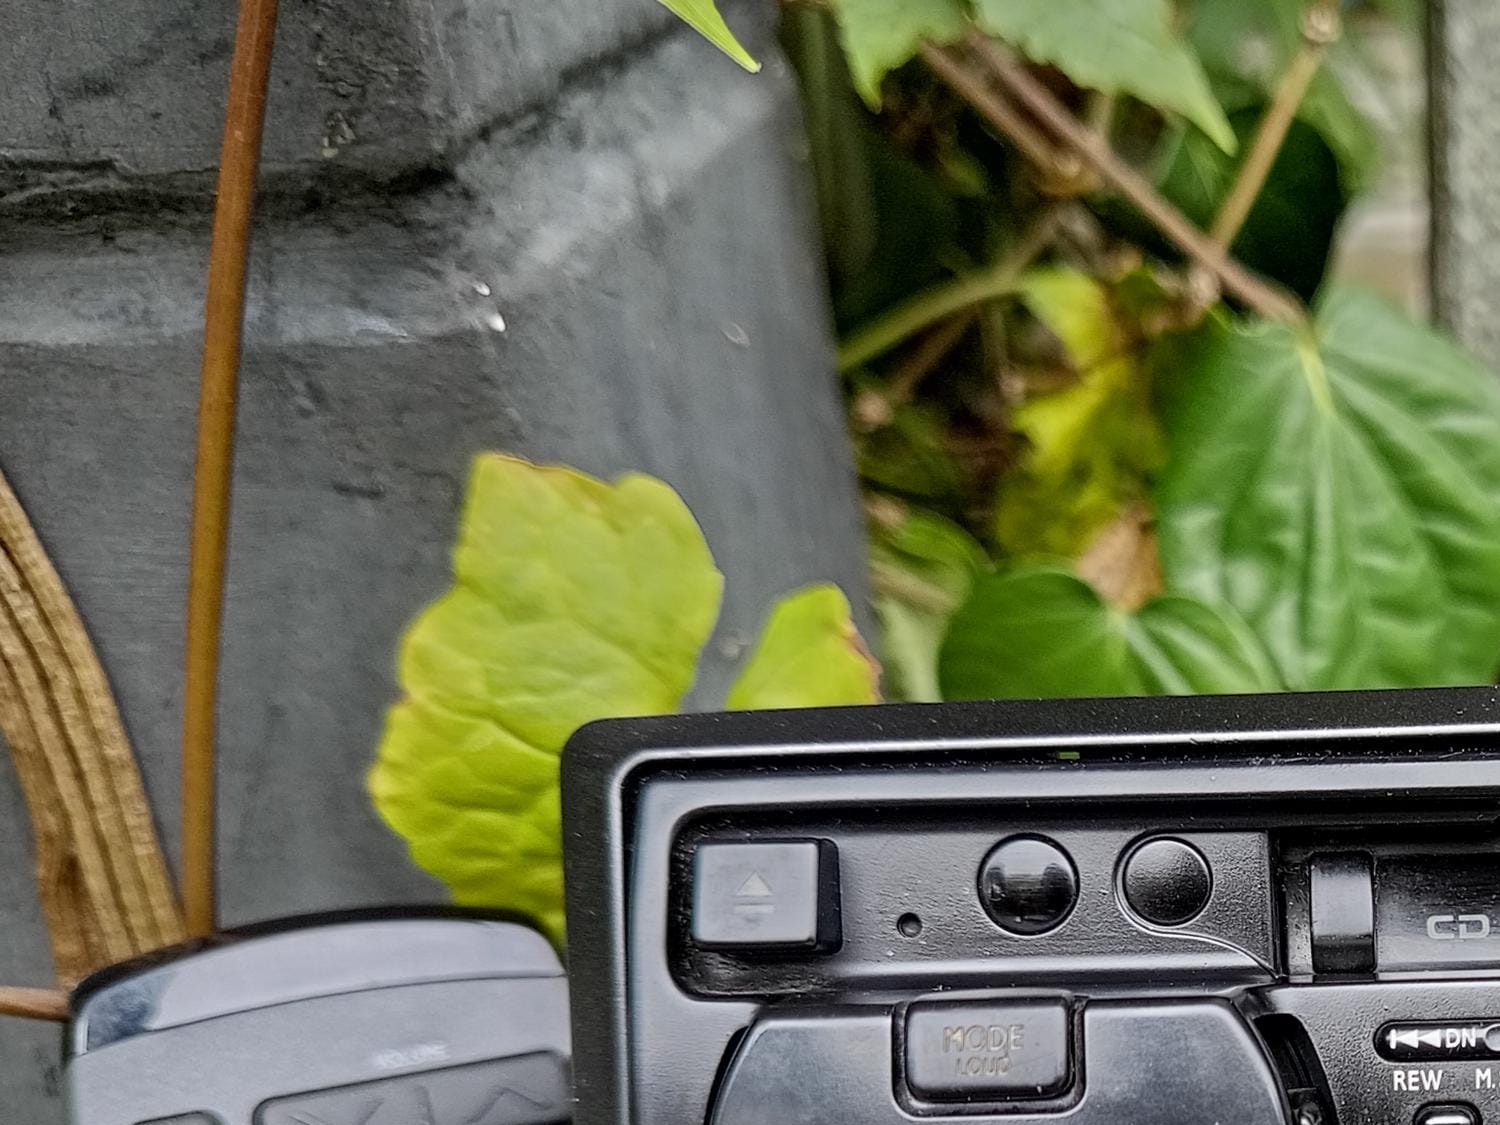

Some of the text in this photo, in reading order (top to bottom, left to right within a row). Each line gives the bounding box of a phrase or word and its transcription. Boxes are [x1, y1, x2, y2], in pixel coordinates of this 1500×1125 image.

[1427, 914, 1490, 940] CD
[943, 1024, 1025, 1053] MODE
[1445, 1028, 1477, 1048] DN
[956, 1054, 1011, 1077] LOUD
[1393, 1069, 1443, 1091] REW
